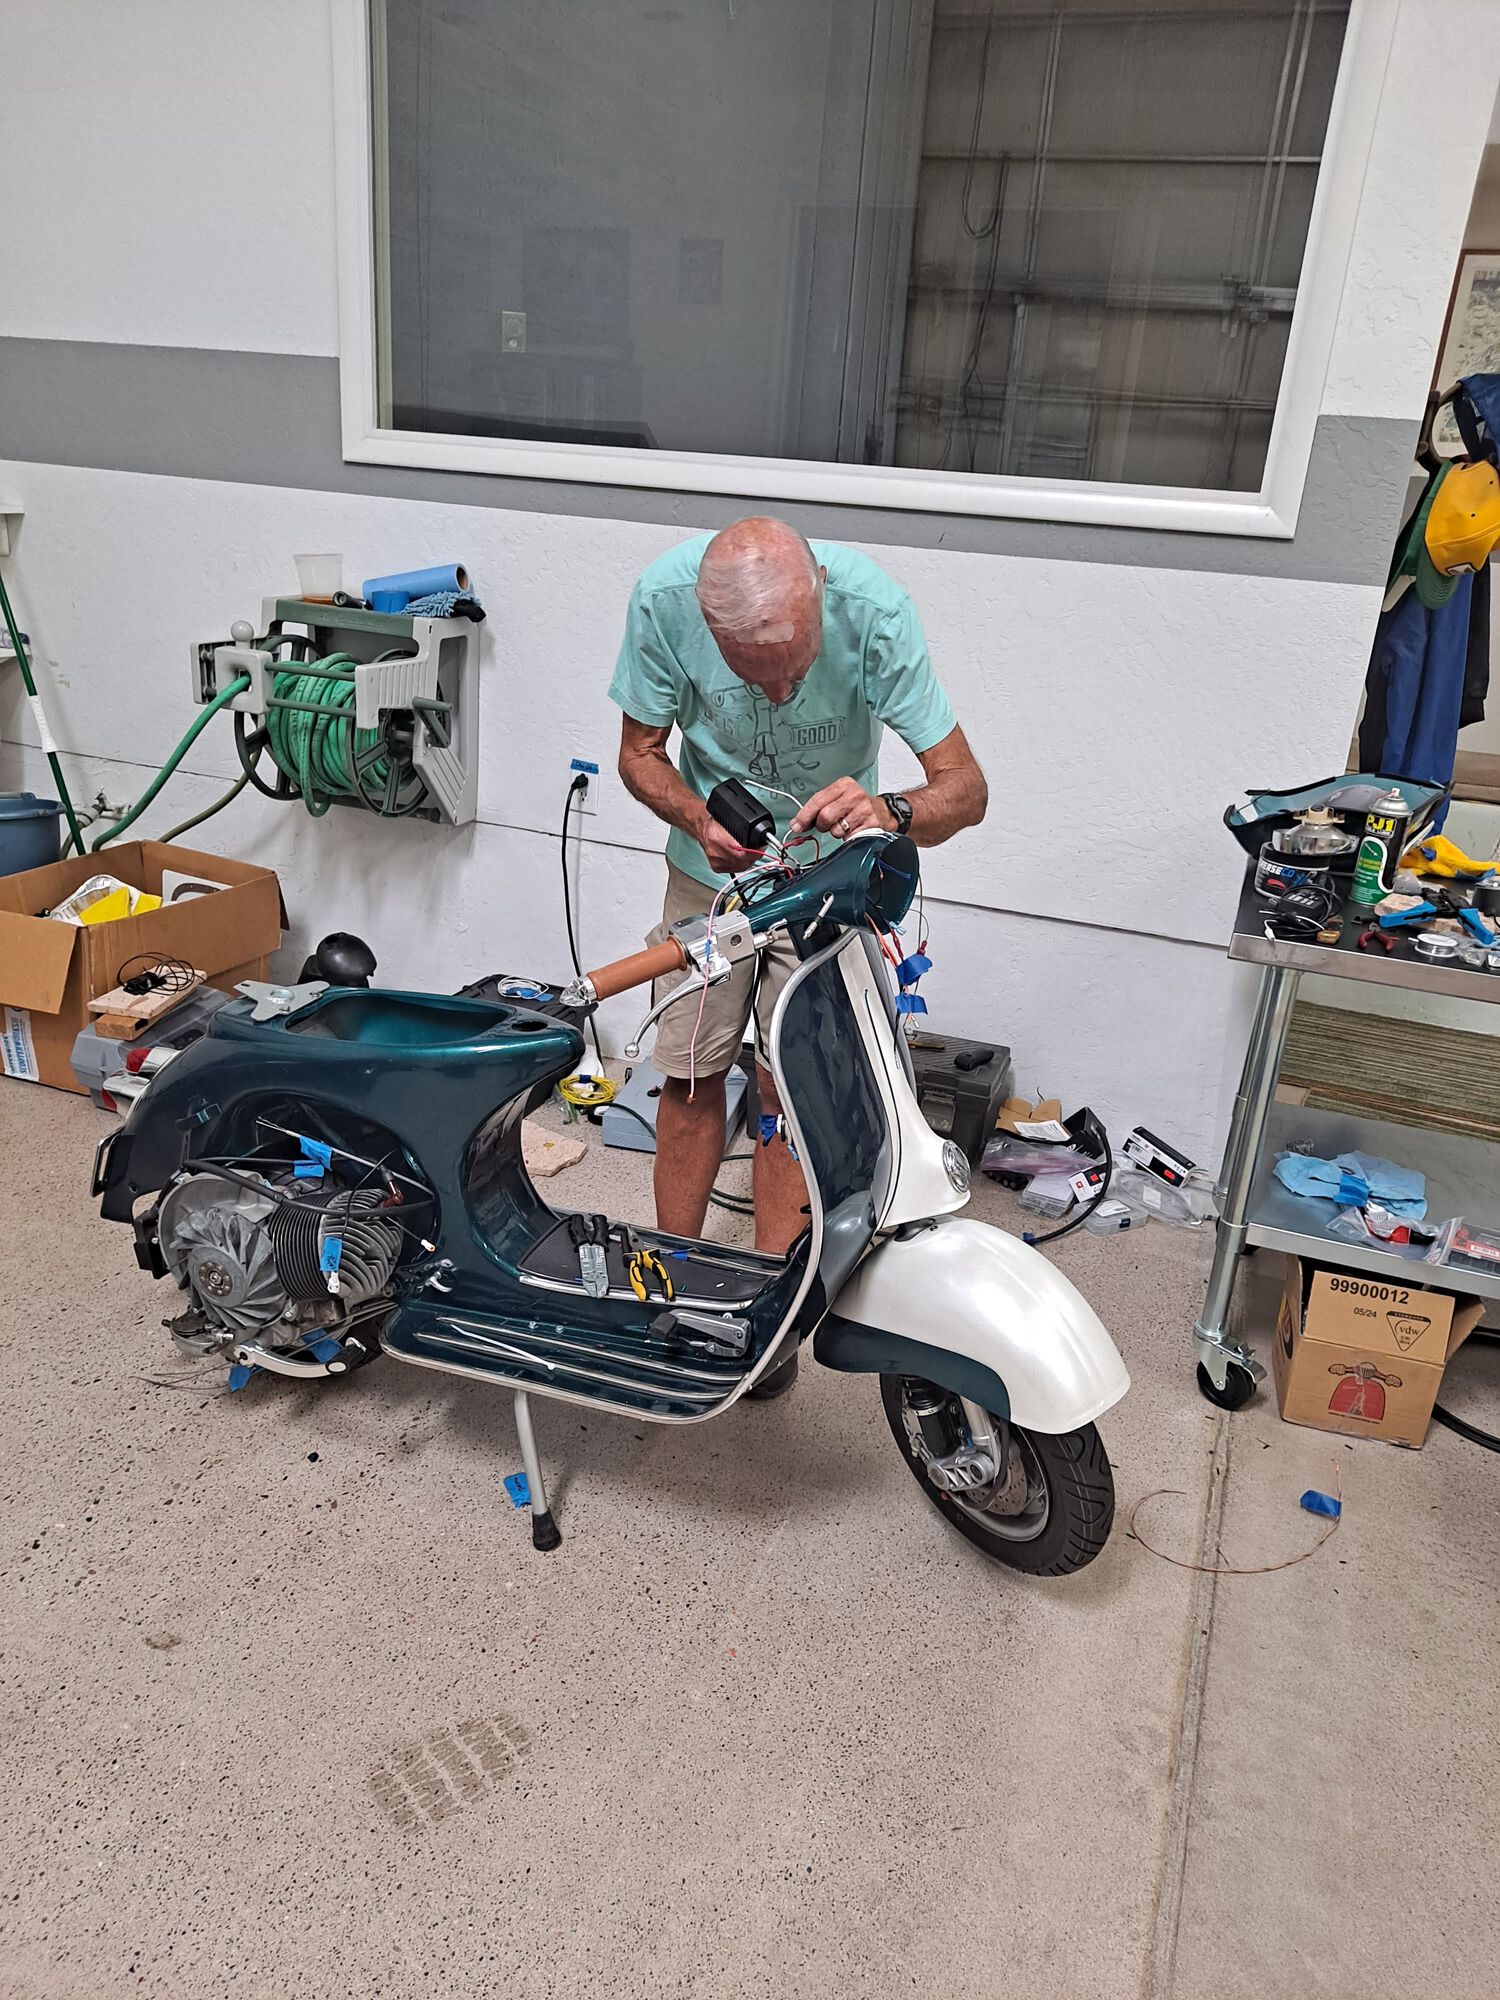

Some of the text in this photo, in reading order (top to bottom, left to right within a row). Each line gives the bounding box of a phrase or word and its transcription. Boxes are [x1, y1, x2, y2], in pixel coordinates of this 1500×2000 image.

[797, 723, 837, 746] GOOD
[1366, 814, 1394, 832] PJ1
[1330, 1277, 1409, 1305] 99900012
[1353, 1306, 1377, 1318] 05/24
[1399, 1325, 1420, 1336] vdw
